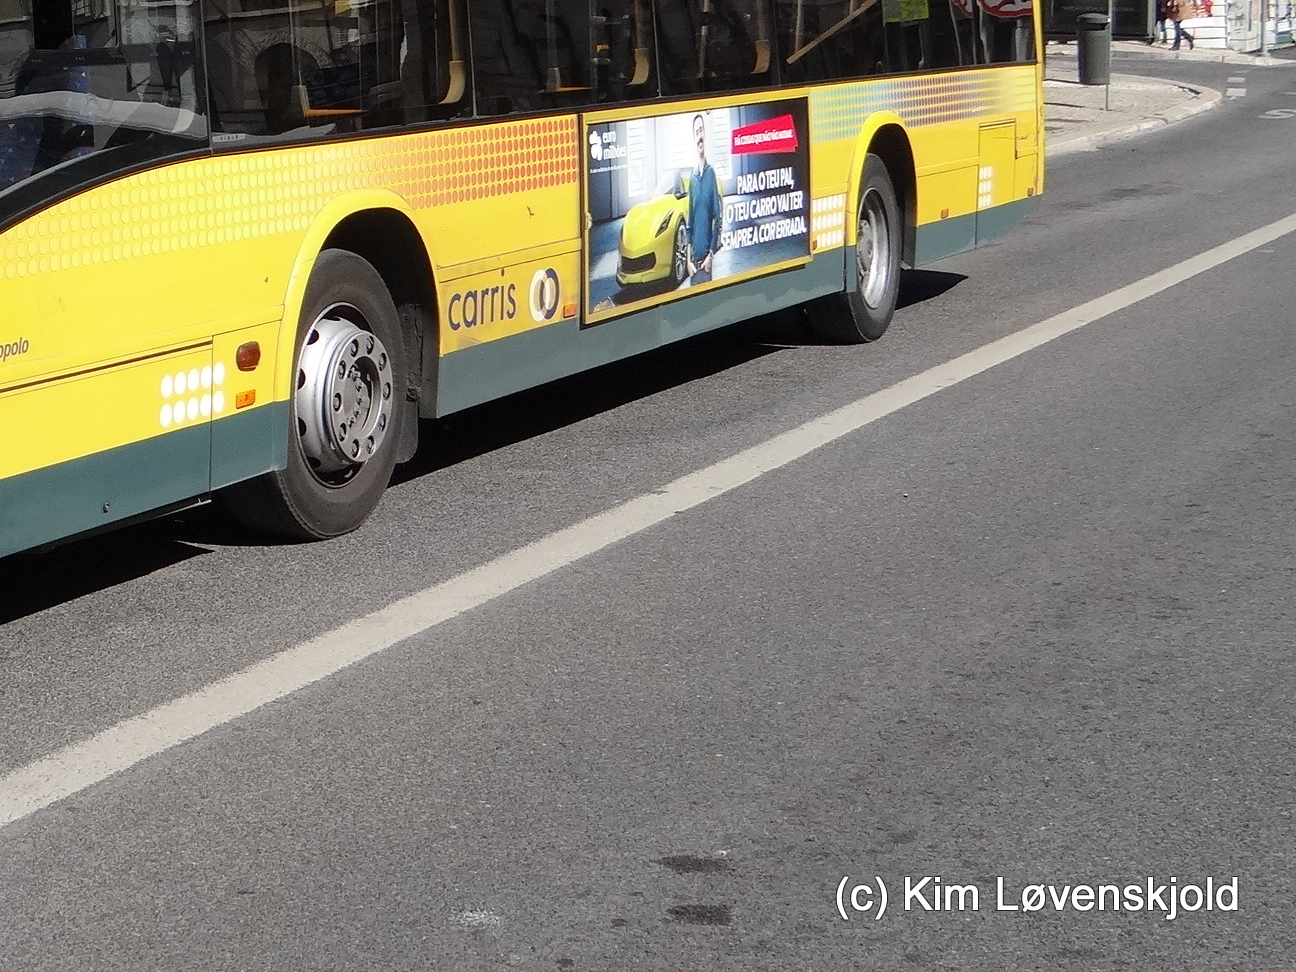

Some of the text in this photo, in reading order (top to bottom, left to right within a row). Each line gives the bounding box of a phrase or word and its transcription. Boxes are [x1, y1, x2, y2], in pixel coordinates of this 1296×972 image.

[737, 173, 759, 194] PARA
[758, 171, 766, 190] O
[765, 168, 779, 189] TEU
[726, 190, 803, 223] O TEU CARRO VAI TER
[720, 215, 807, 250] SEMPRE A COR ERRADA.
[448, 268, 516, 331] carris
